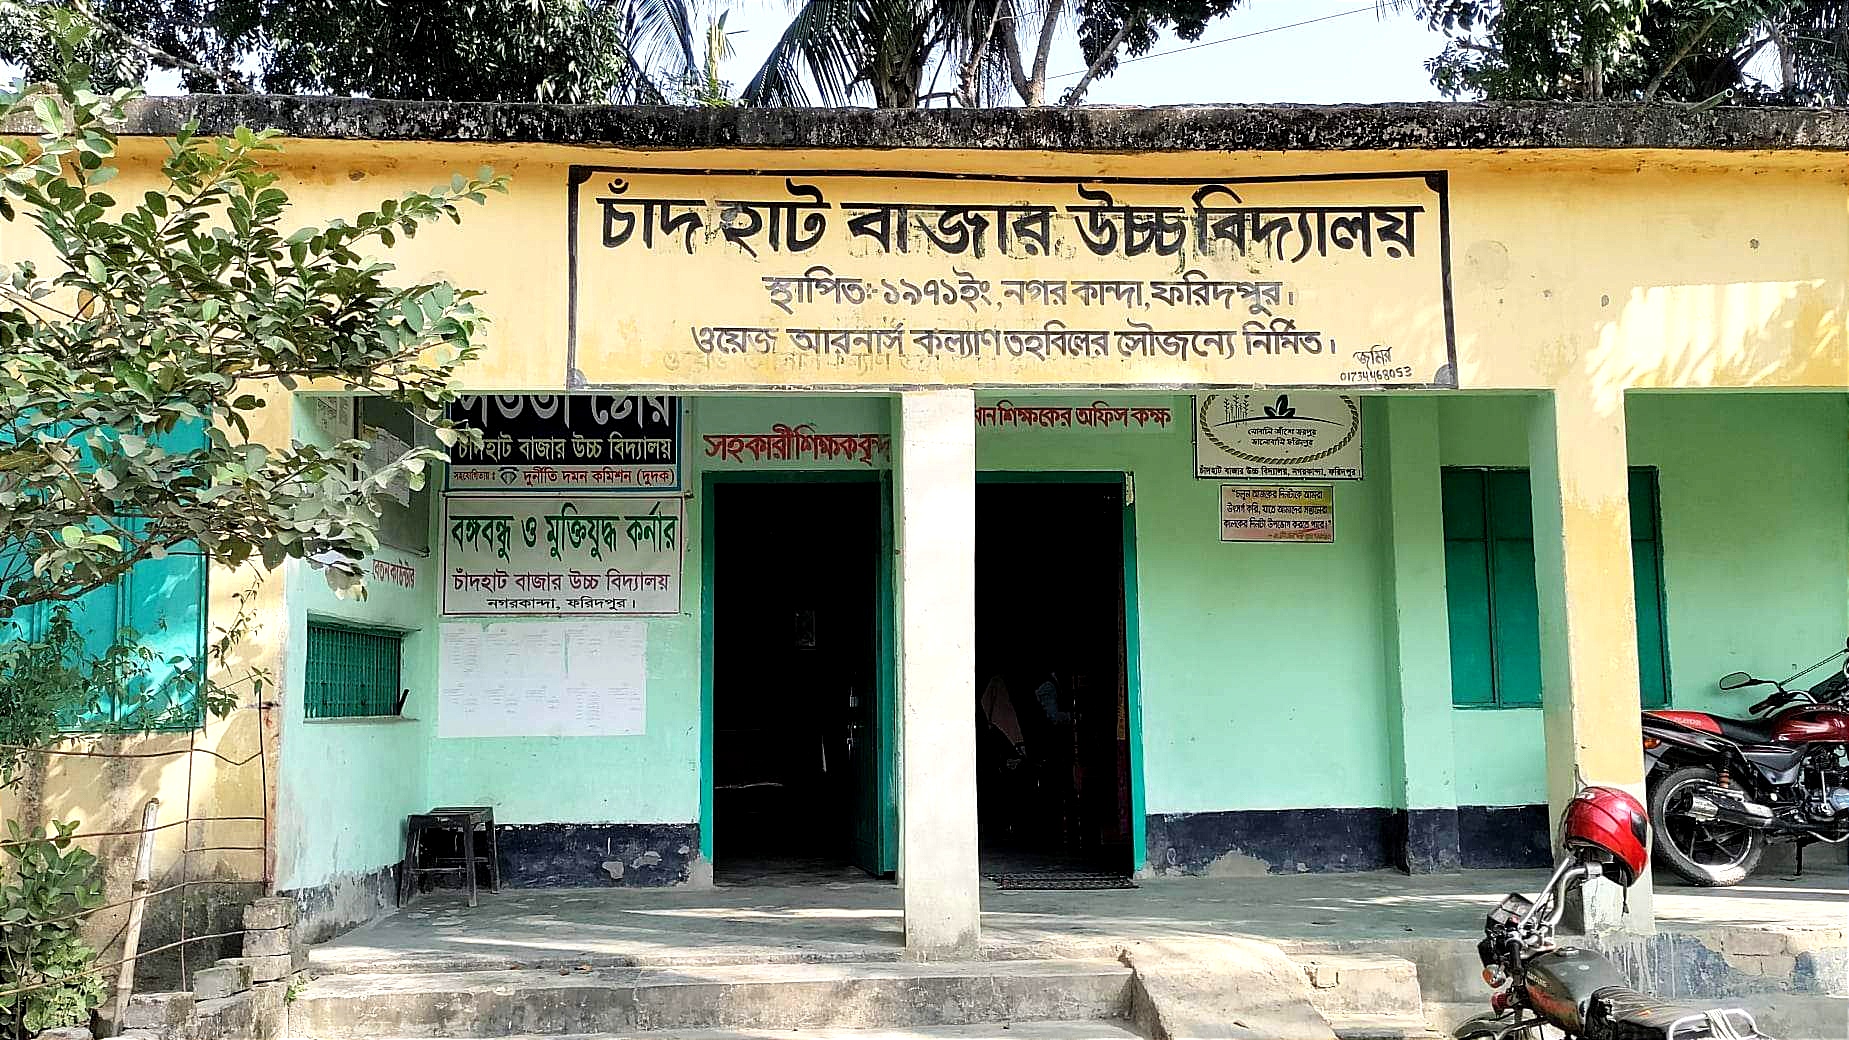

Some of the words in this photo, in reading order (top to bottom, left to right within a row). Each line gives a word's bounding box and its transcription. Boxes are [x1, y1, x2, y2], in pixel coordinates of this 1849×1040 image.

[841, 201, 1057, 260] বাজার
[1114, 317, 1237, 361] সৌজন্যে
[1075, 400, 1129, 428] অফিস
[517, 435, 566, 461] বাজার
[571, 431, 603, 460] উচ্চ
[608, 431, 672, 461] বিদ্যালয়
[562, 470, 588, 484] দমন
[591, 467, 632, 484] কমিশন
[636, 469, 675, 487] (দুদক)
[449, 515, 515, 563] বঙ্গবন্ধু
[521, 516, 538, 548] ও
[544, 501, 620, 562] মুক্তিযুদ্ধ
[452, 567, 509, 592] চাঁদহাট
[513, 570, 564, 592] বাজার
[568, 568, 601, 592] উচ্চ
[605, 567, 671, 592] বিদ্যালয়
